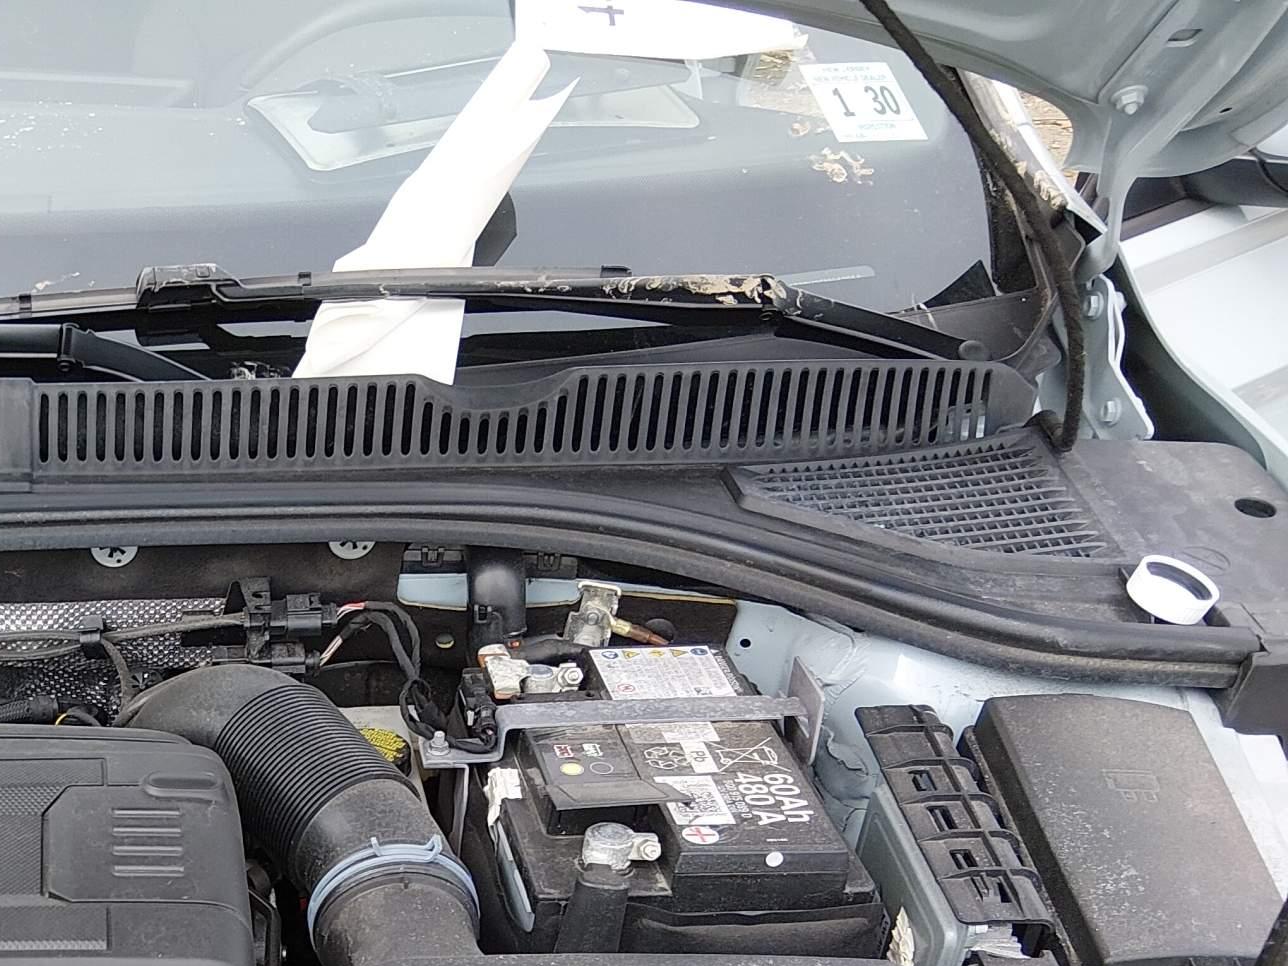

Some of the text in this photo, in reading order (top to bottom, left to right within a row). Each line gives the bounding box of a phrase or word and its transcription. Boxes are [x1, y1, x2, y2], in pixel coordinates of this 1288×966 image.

[832, 85, 901, 117] 1 30
[690, 750, 709, 764] Pb
[734, 771, 788, 826] 480 A
[763, 772, 814, 824] 60Ah
